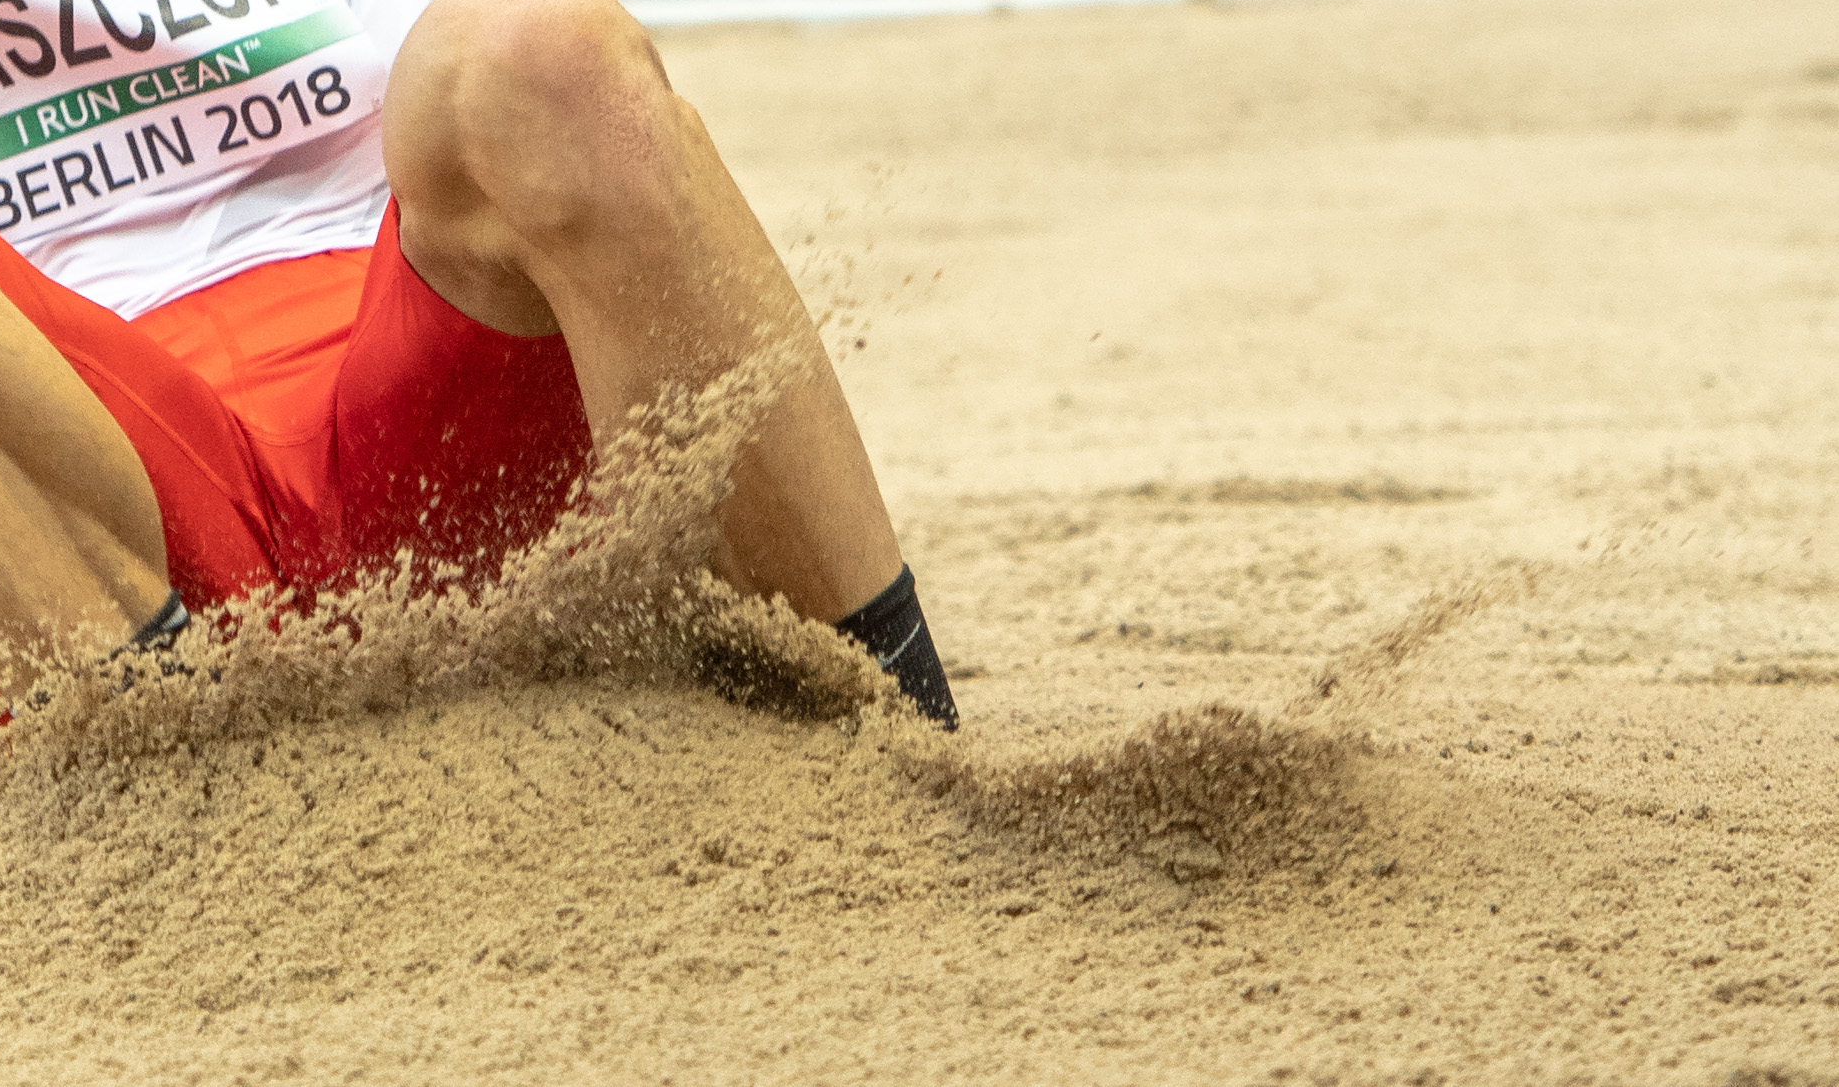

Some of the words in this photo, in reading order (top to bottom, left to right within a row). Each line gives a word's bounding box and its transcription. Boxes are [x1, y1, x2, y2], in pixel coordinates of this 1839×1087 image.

[14, 115, 30, 147] I
[37, 85, 121, 140] RUN
[205, 64, 352, 154] 2018
